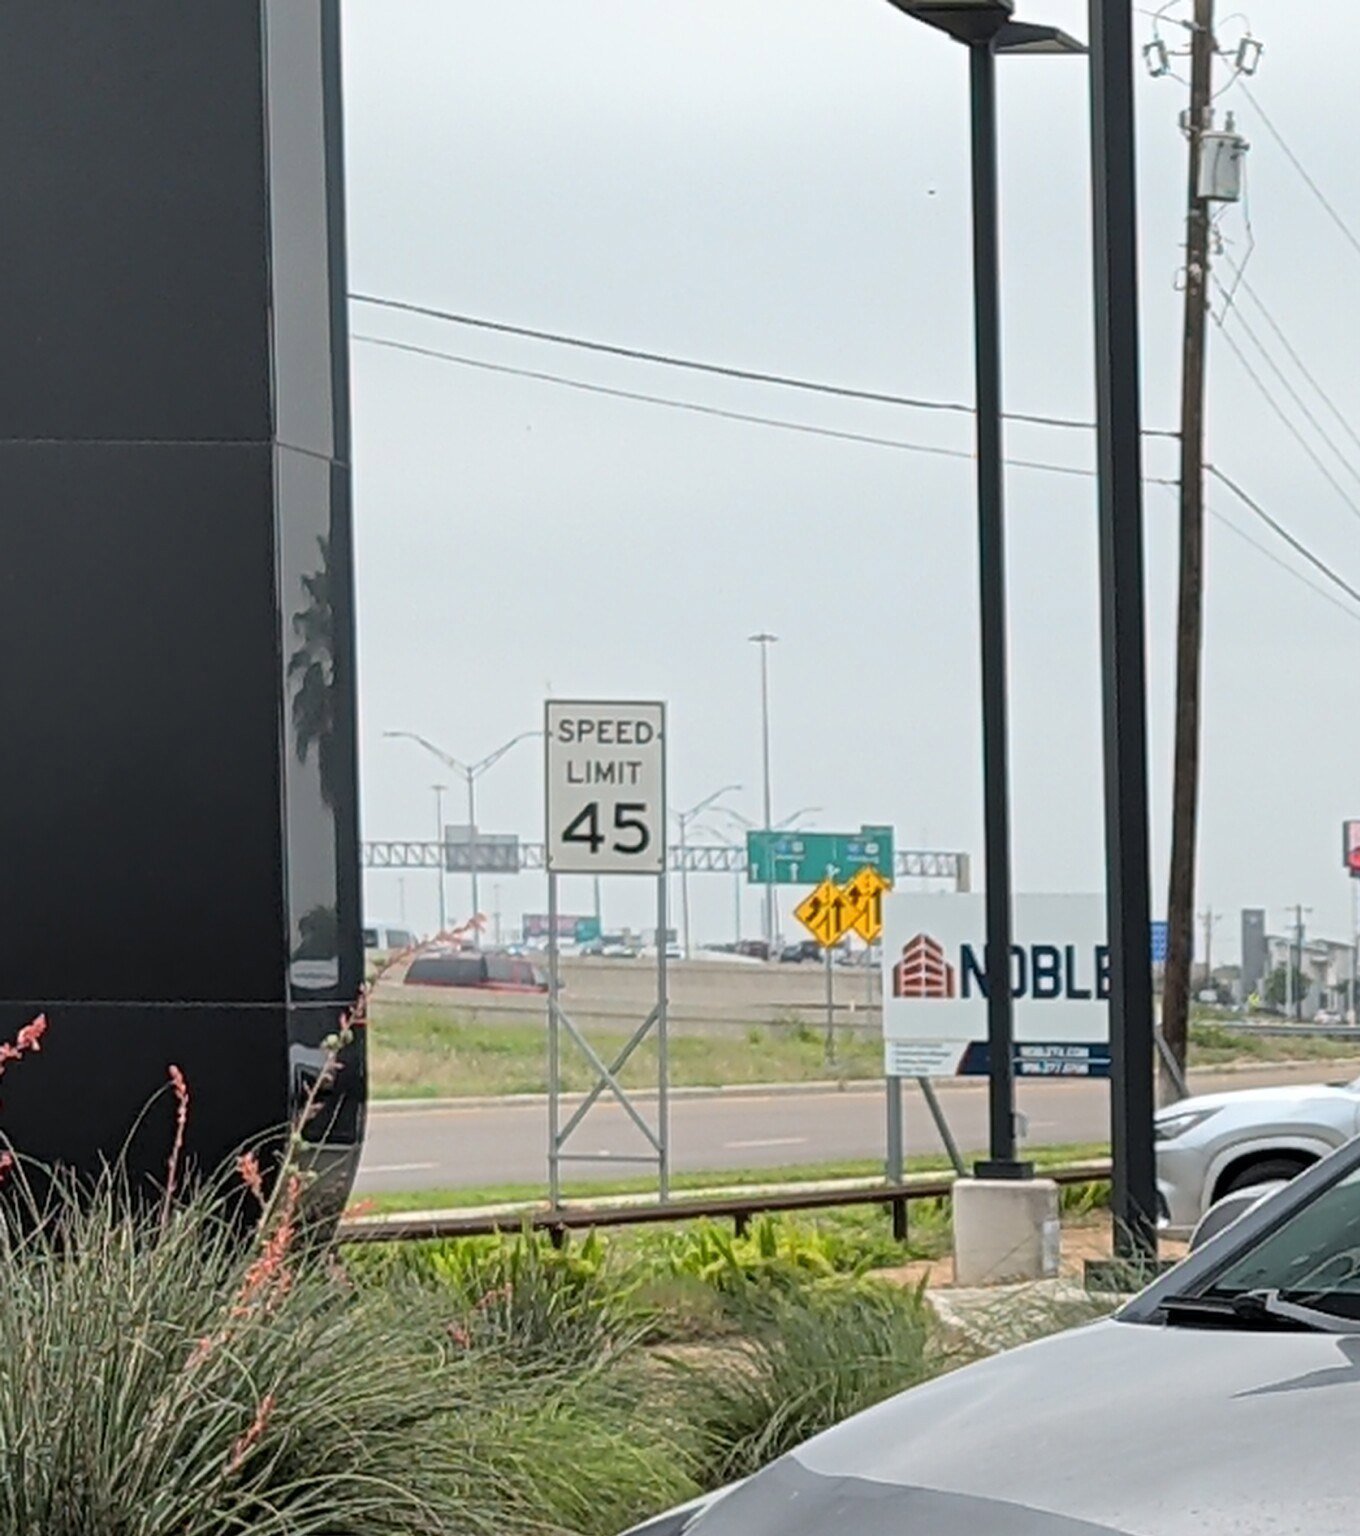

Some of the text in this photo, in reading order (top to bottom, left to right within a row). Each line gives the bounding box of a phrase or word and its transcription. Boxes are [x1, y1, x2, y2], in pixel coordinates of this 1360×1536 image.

[558, 719, 654, 744] SPEED
[567, 761, 643, 785] LIMIT
[561, 802, 650, 855] 45
